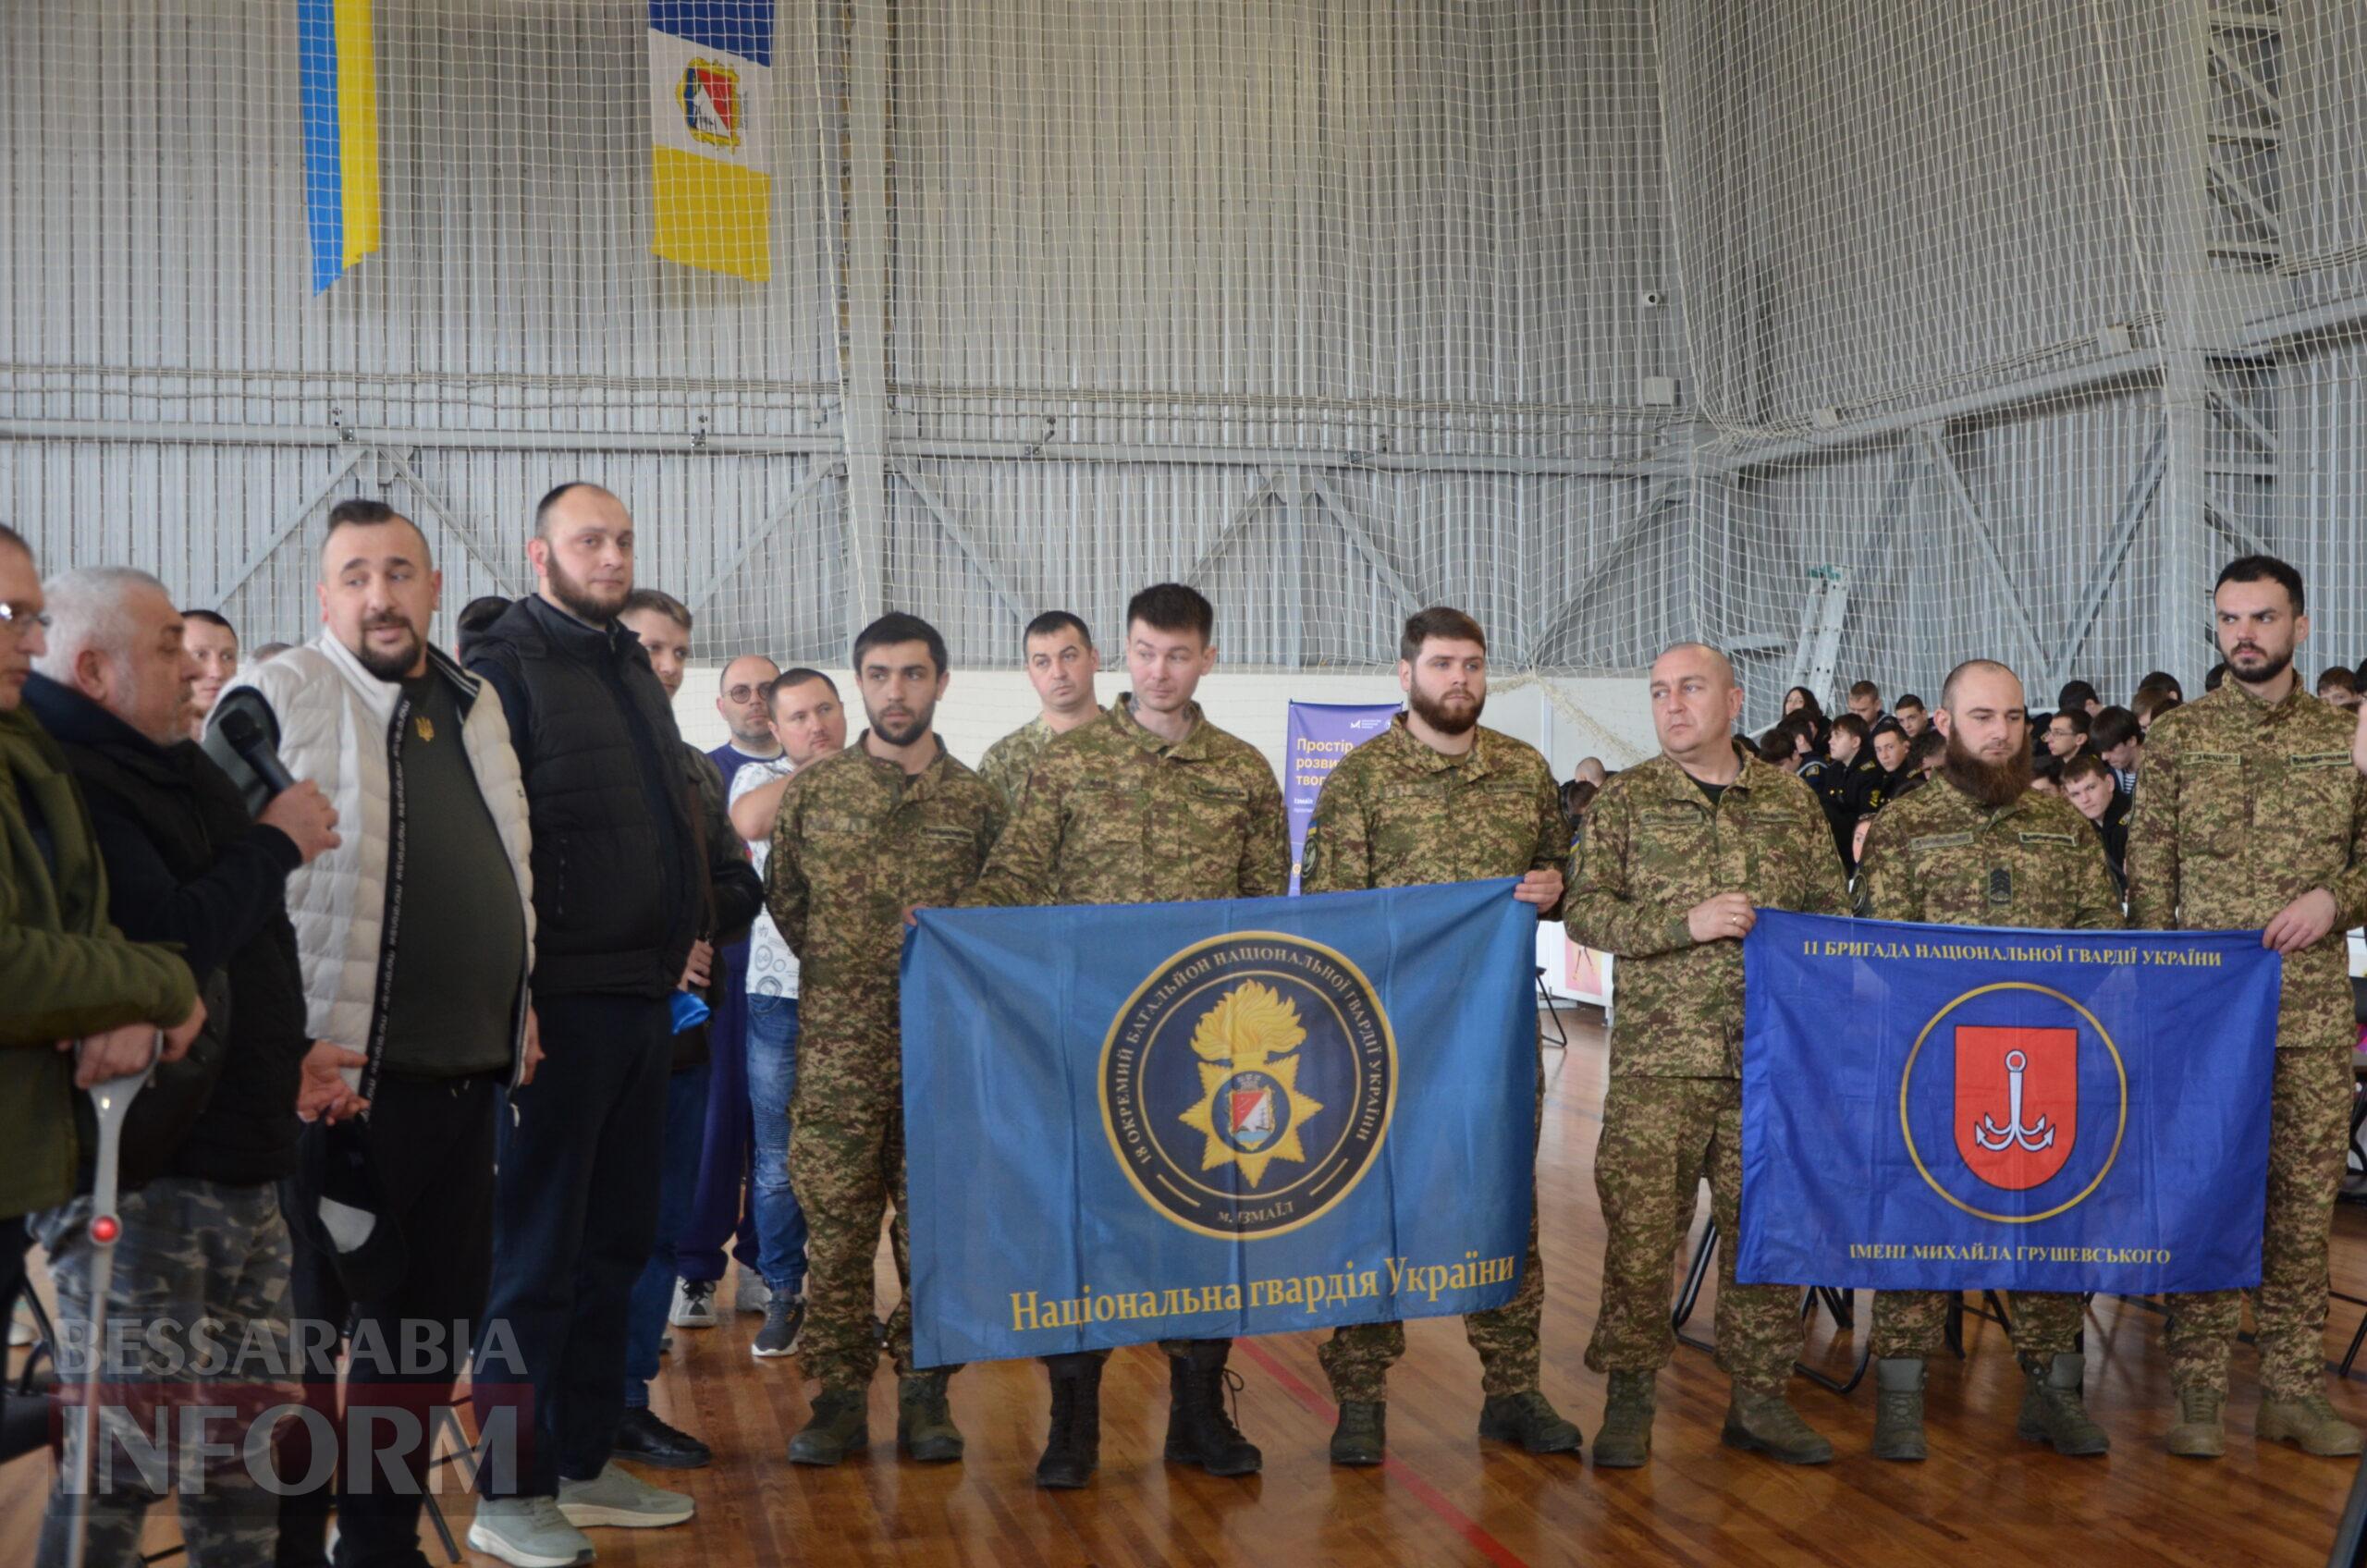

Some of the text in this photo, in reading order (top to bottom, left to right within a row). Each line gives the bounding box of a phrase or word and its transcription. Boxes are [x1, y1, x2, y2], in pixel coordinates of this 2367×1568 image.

[1296, 738, 1354, 754] Простір
[1296, 757, 1340, 771] розви
[1296, 776, 1326, 786] твог
[1804, 940, 2223, 967] 11 БРИГАДА НАЦІОНАЛЬНОЇ ГВАРДІЇ УКРАЇНИ
[1116, 948, 1382, 1164] 18 ОКРЕМИЙ БАТАЛЬЙОН НАЦІОНАЛЬНОЇ ГВАРДІЇ УКРАЇНИ
[1849, 1243, 2171, 1265] ІМЕНІ МИХАЙЛА ГРУШЕВСЬКОГО
[1011, 1252, 1515, 1332] Національна гвардія України
